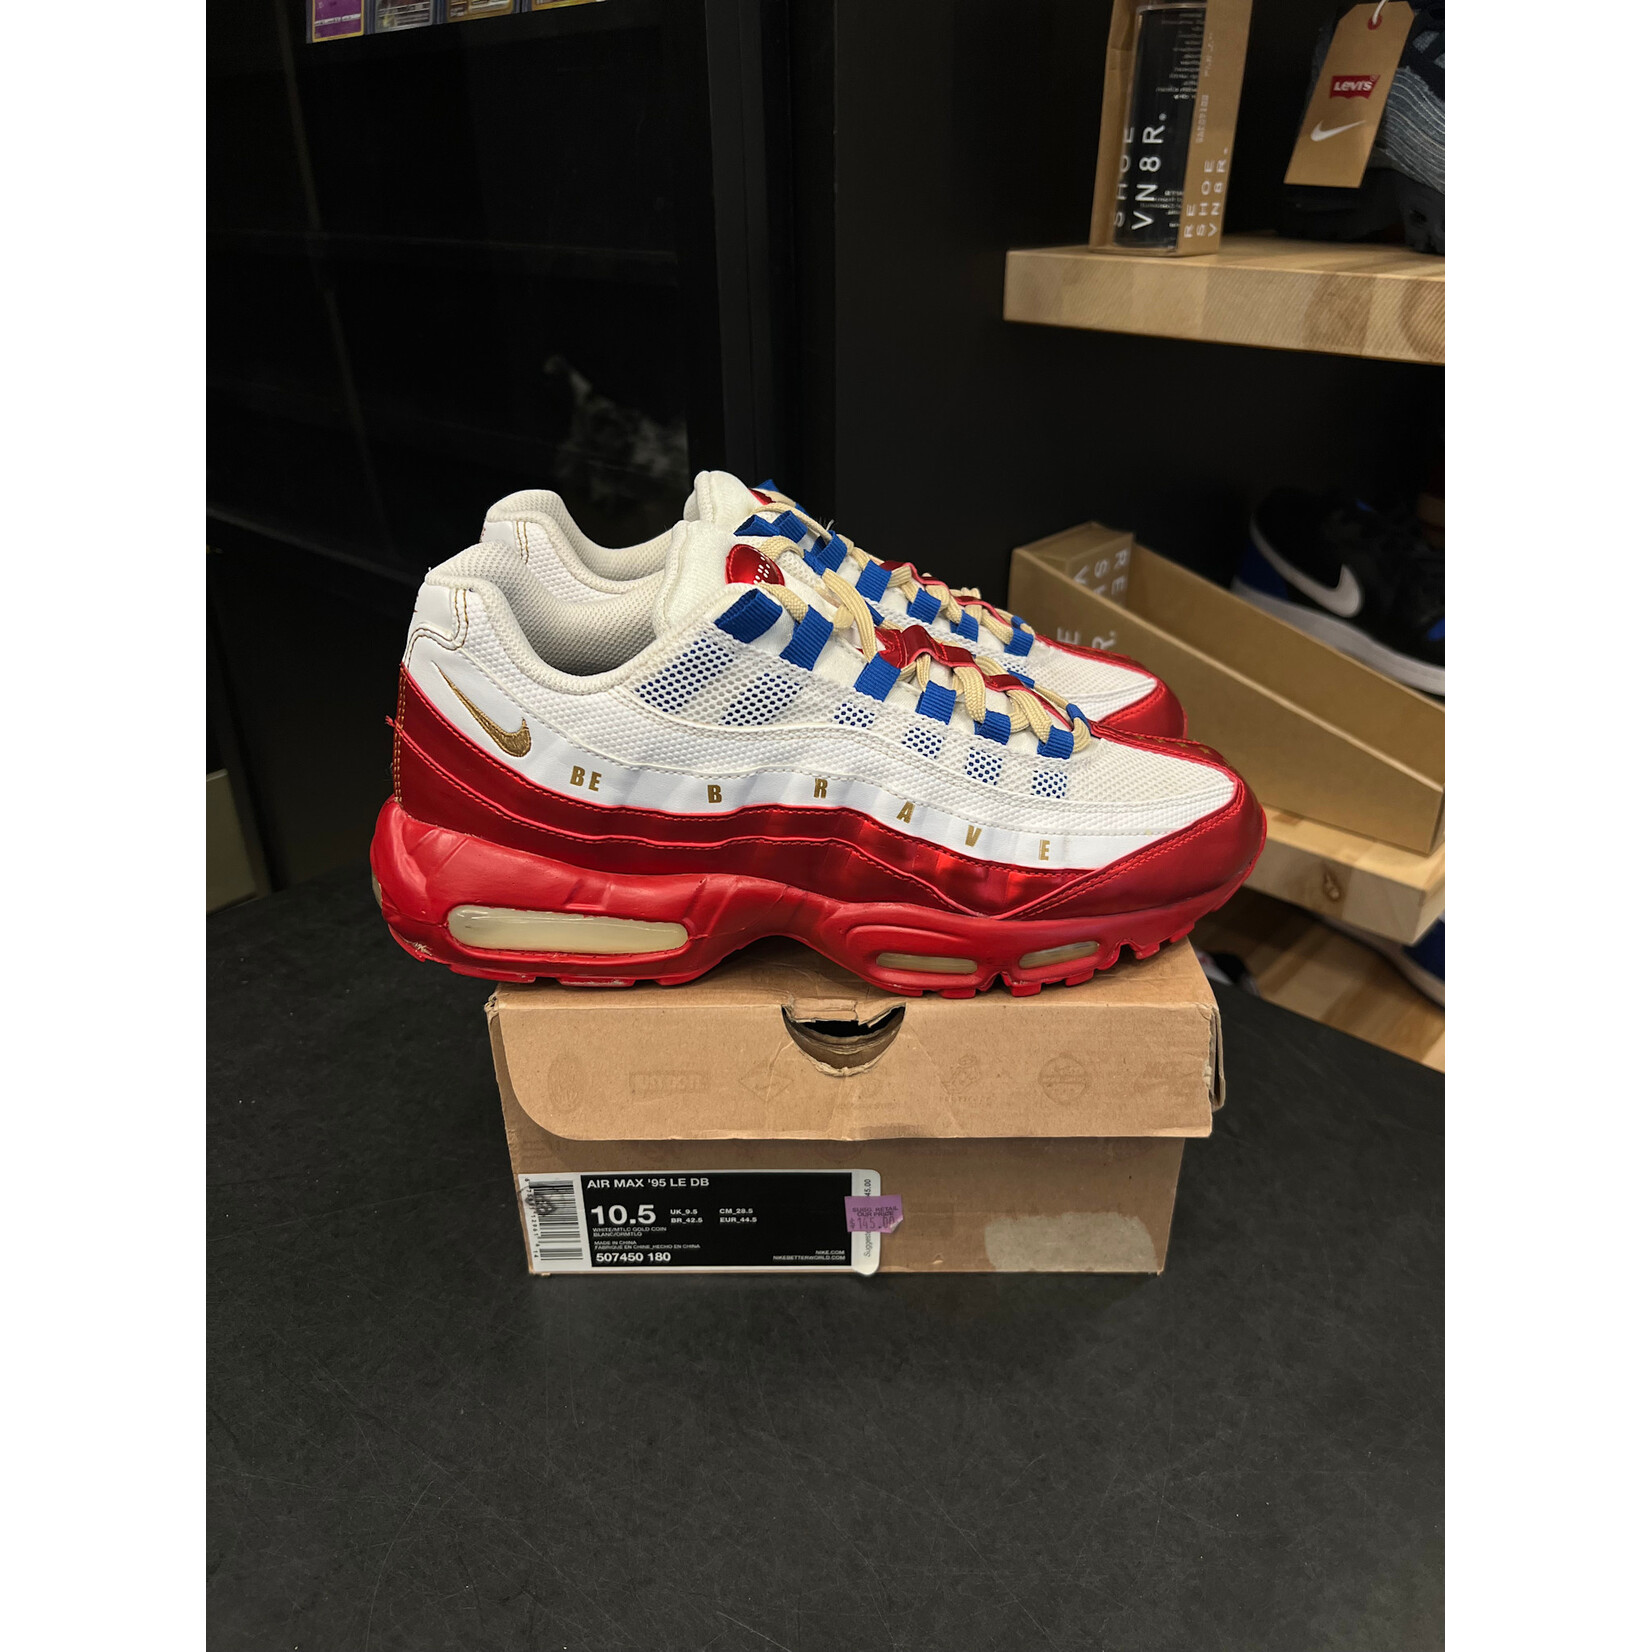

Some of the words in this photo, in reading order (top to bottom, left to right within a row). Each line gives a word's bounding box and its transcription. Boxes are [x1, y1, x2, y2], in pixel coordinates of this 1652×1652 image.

[1131, 112, 1168, 231] VN8R.
[1196, 160, 1215, 236] SHOE
[1183, 203, 1197, 238] RE
[570, 765, 602, 792] BE
[587, 1179, 610, 1189] AIR
[613, 1178, 645, 1188] MAX
[648, 1178, 667, 1187] '95
[670, 1177, 687, 1187] LE
[690, 1177, 709, 1187] DB
[591, 1204, 656, 1225] 10.5
[596, 1253, 644, 1263] 507450
[647, 1252, 672, 1262] 180
